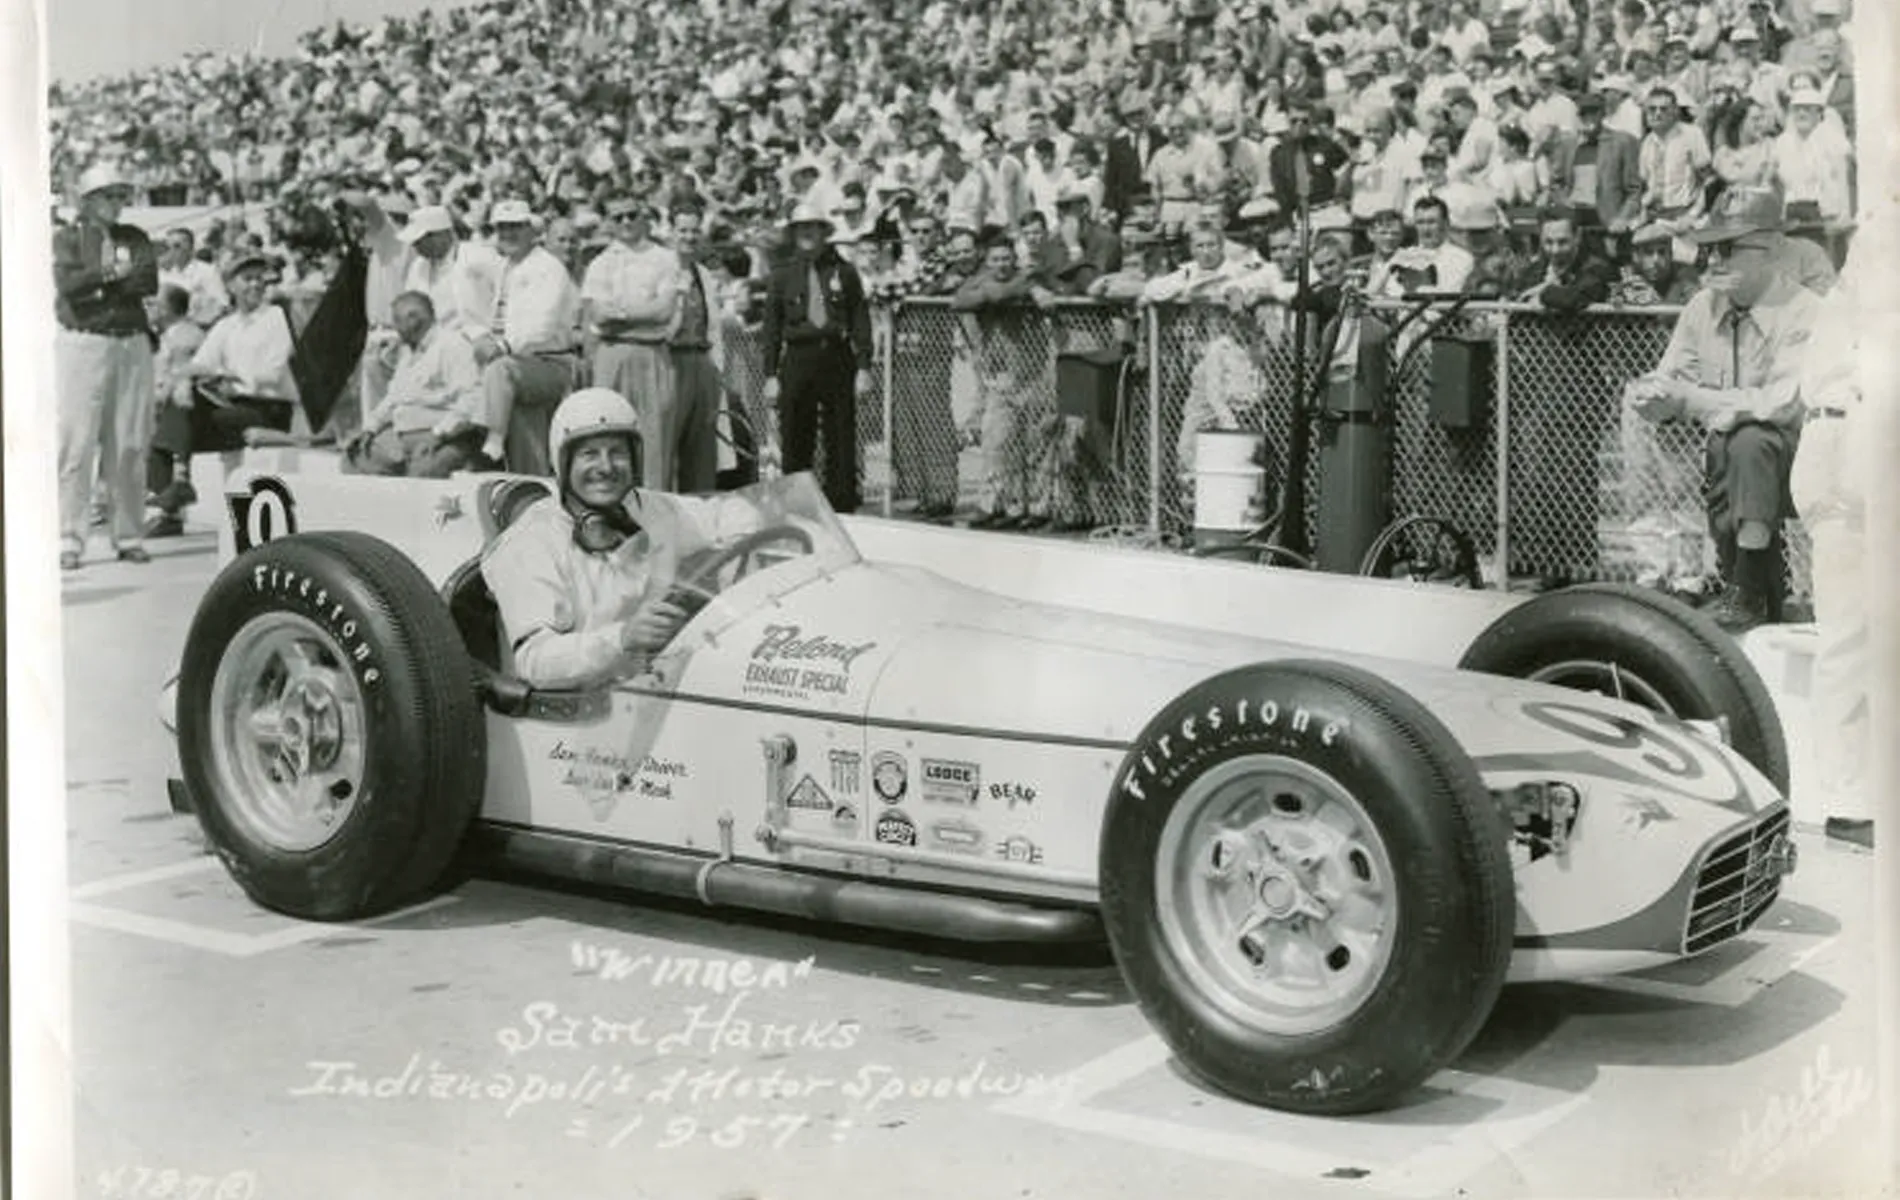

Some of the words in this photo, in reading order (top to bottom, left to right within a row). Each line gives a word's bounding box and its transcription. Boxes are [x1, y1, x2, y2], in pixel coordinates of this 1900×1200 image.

[253, 564, 380, 684] Firestone
[746, 662, 799, 687] EXHAUST
[800, 671, 849, 695] SPECIAL
[1121, 698, 1340, 800] Firestone
